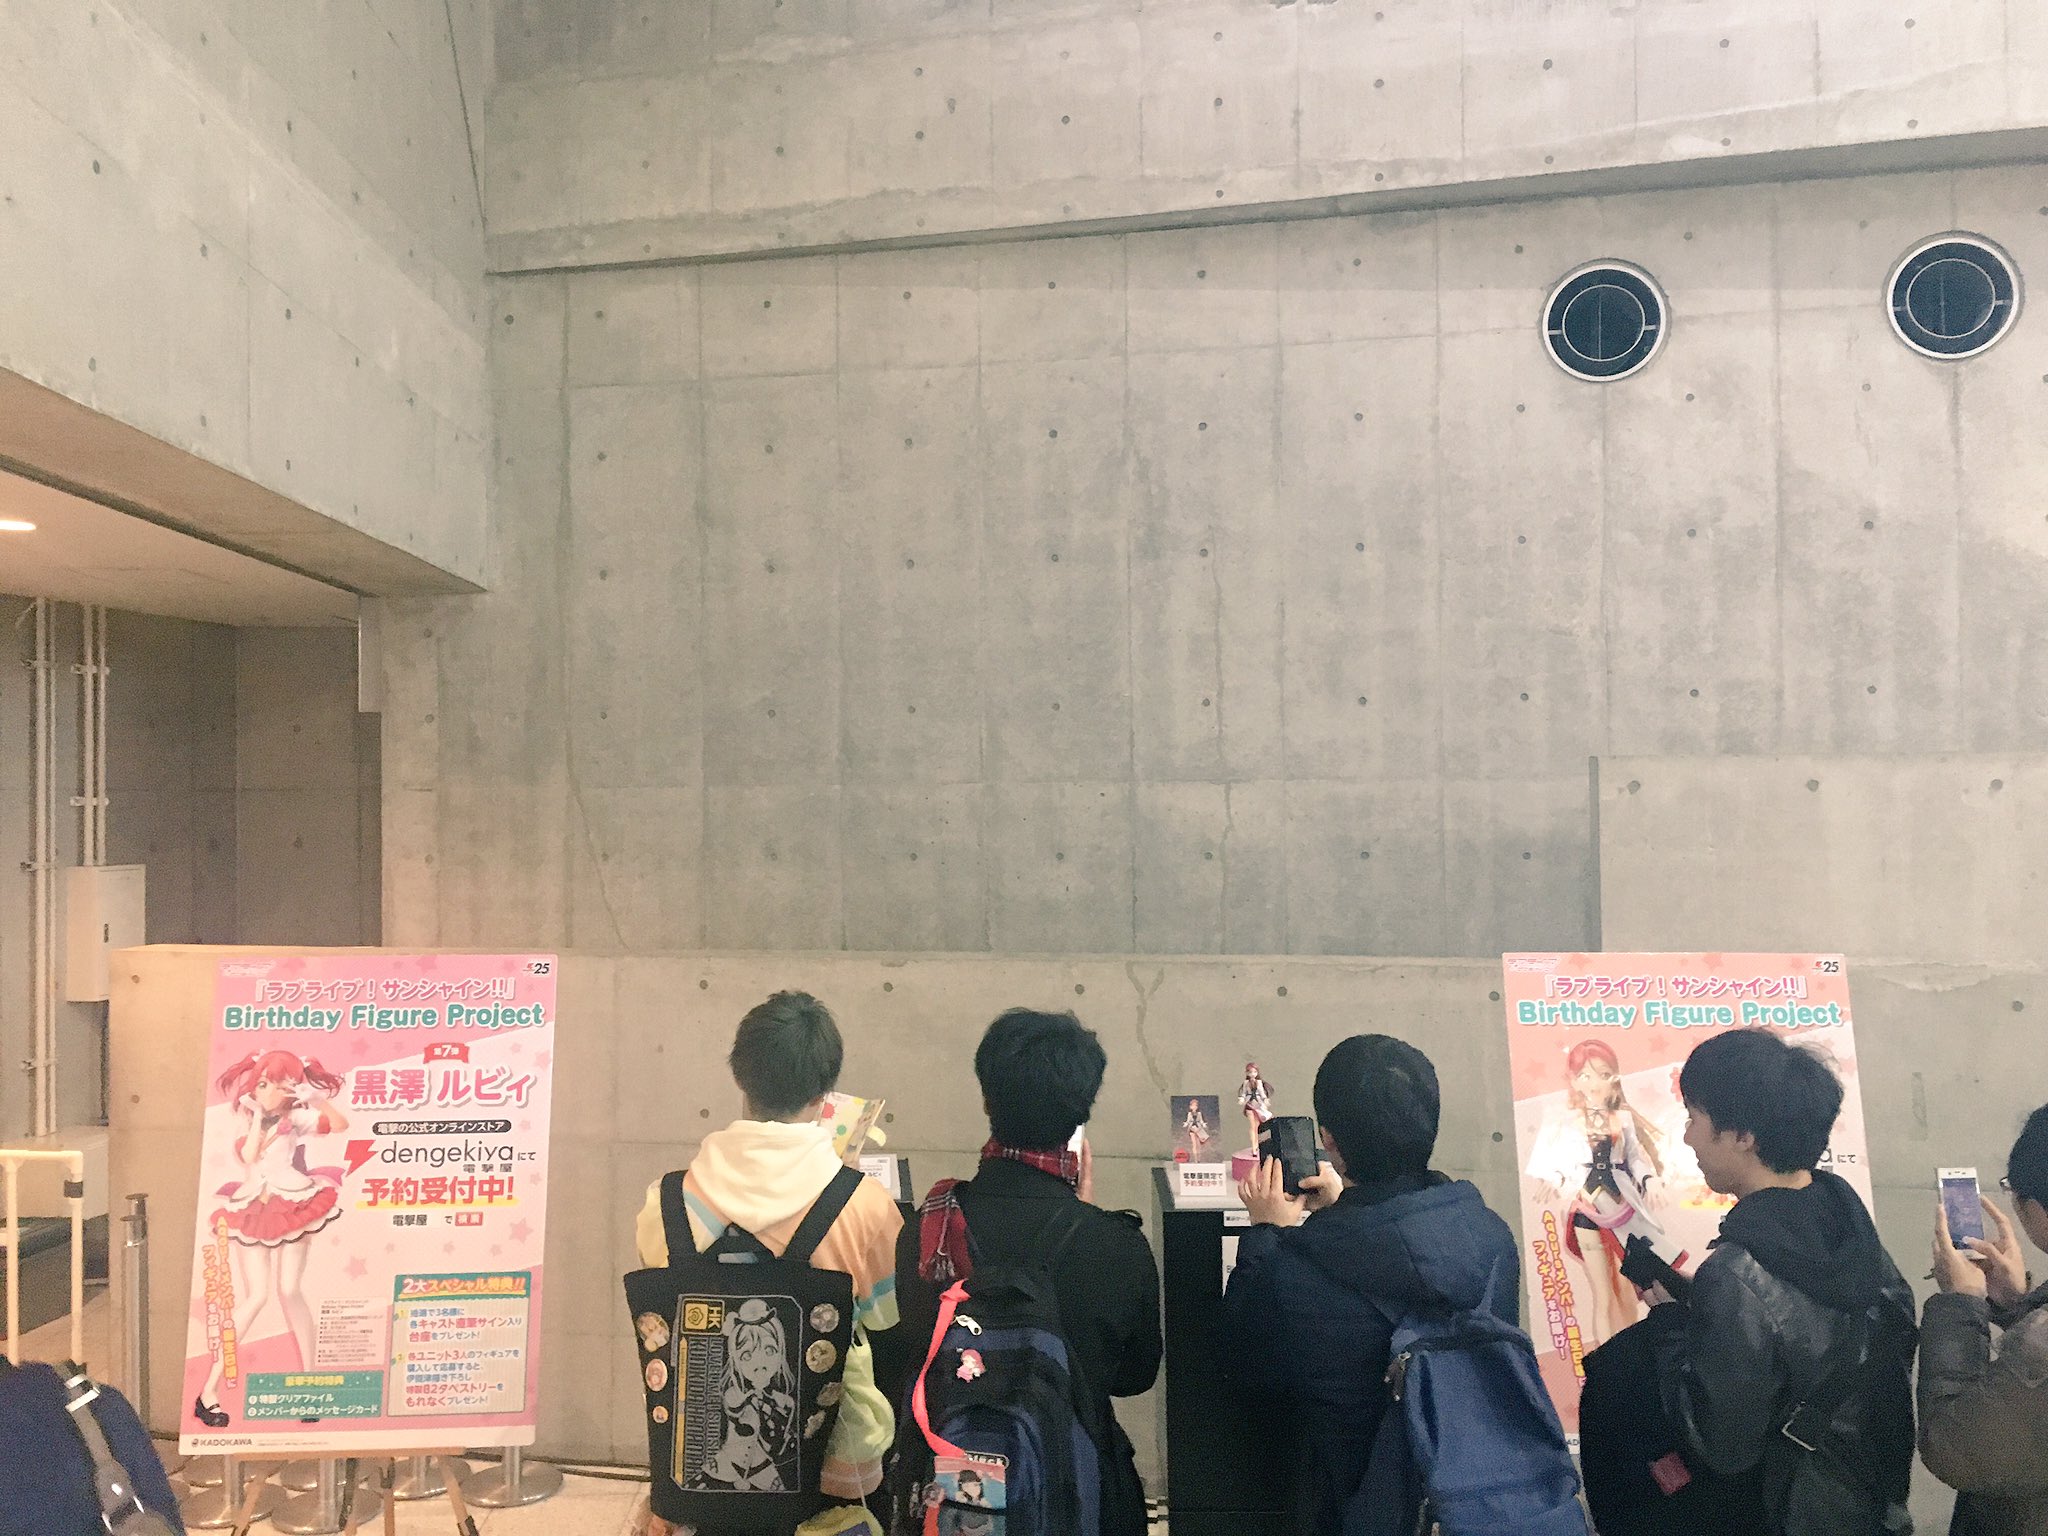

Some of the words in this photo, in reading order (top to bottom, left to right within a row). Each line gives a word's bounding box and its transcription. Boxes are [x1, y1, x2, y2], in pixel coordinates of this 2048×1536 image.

[534, 963, 550, 974] 25
[1823, 961, 1839, 973] 25
[224, 1005, 342, 1031] Birthday
[351, 1004, 437, 1030] Figure
[447, 1002, 544, 1028] Project
[1518, 1001, 1636, 1027] Birthday
[1645, 1001, 1733, 1027] Figure
[1742, 1001, 1840, 1027] Project
[351, 1069, 425, 1105] 黒澤
[437, 1066, 531, 1102] ルビィ
[377, 1121, 505, 1134] 電撃の公式オンラインストア
[380, 1139, 514, 1168] dengekiya
[517, 1151, 536, 1161] にて
[1836, 1154, 1856, 1164] にて
[361, 1175, 515, 1207] 予約受付中!
[392, 1214, 428, 1226] 電撃屋
[707, 1305, 721, 1329] HK
[200, 1438, 253, 1447] KADOKAWA
